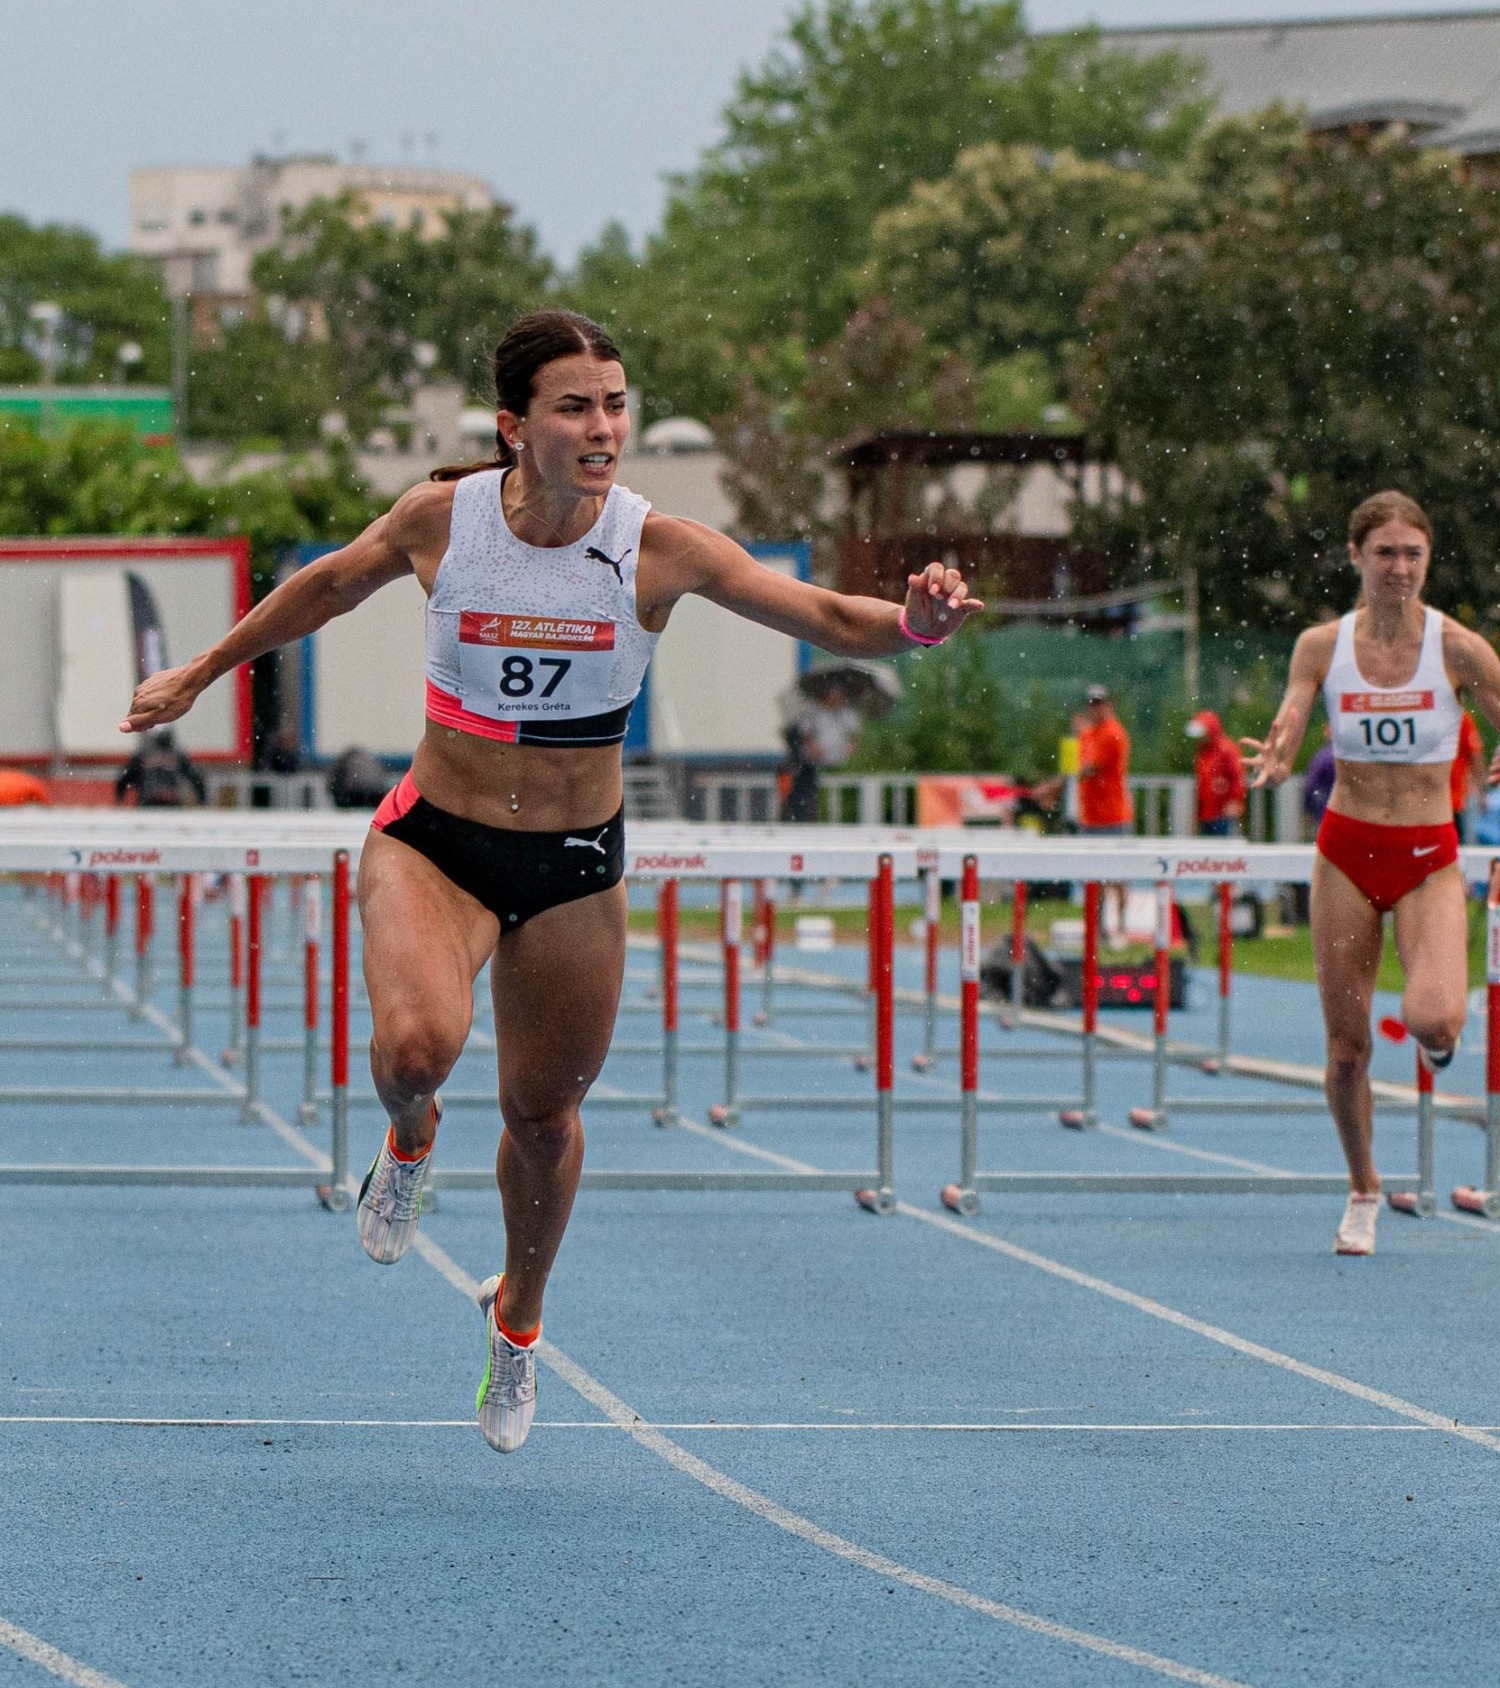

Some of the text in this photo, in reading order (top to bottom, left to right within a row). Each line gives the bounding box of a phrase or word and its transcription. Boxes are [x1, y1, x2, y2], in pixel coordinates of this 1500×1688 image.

[510, 620, 596, 635] 127. ATLÉTIKAI
[510, 630, 595, 643] MAGYAR BAJNOKSÁG
[499, 655, 572, 698] 87
[498, 702, 571, 711] Kerekes Gréta
[1359, 717, 1416, 746] 101
[90, 849, 161, 867] polanik
[634, 853, 707, 871] polanik
[1175, 856, 1248, 875] polanik
